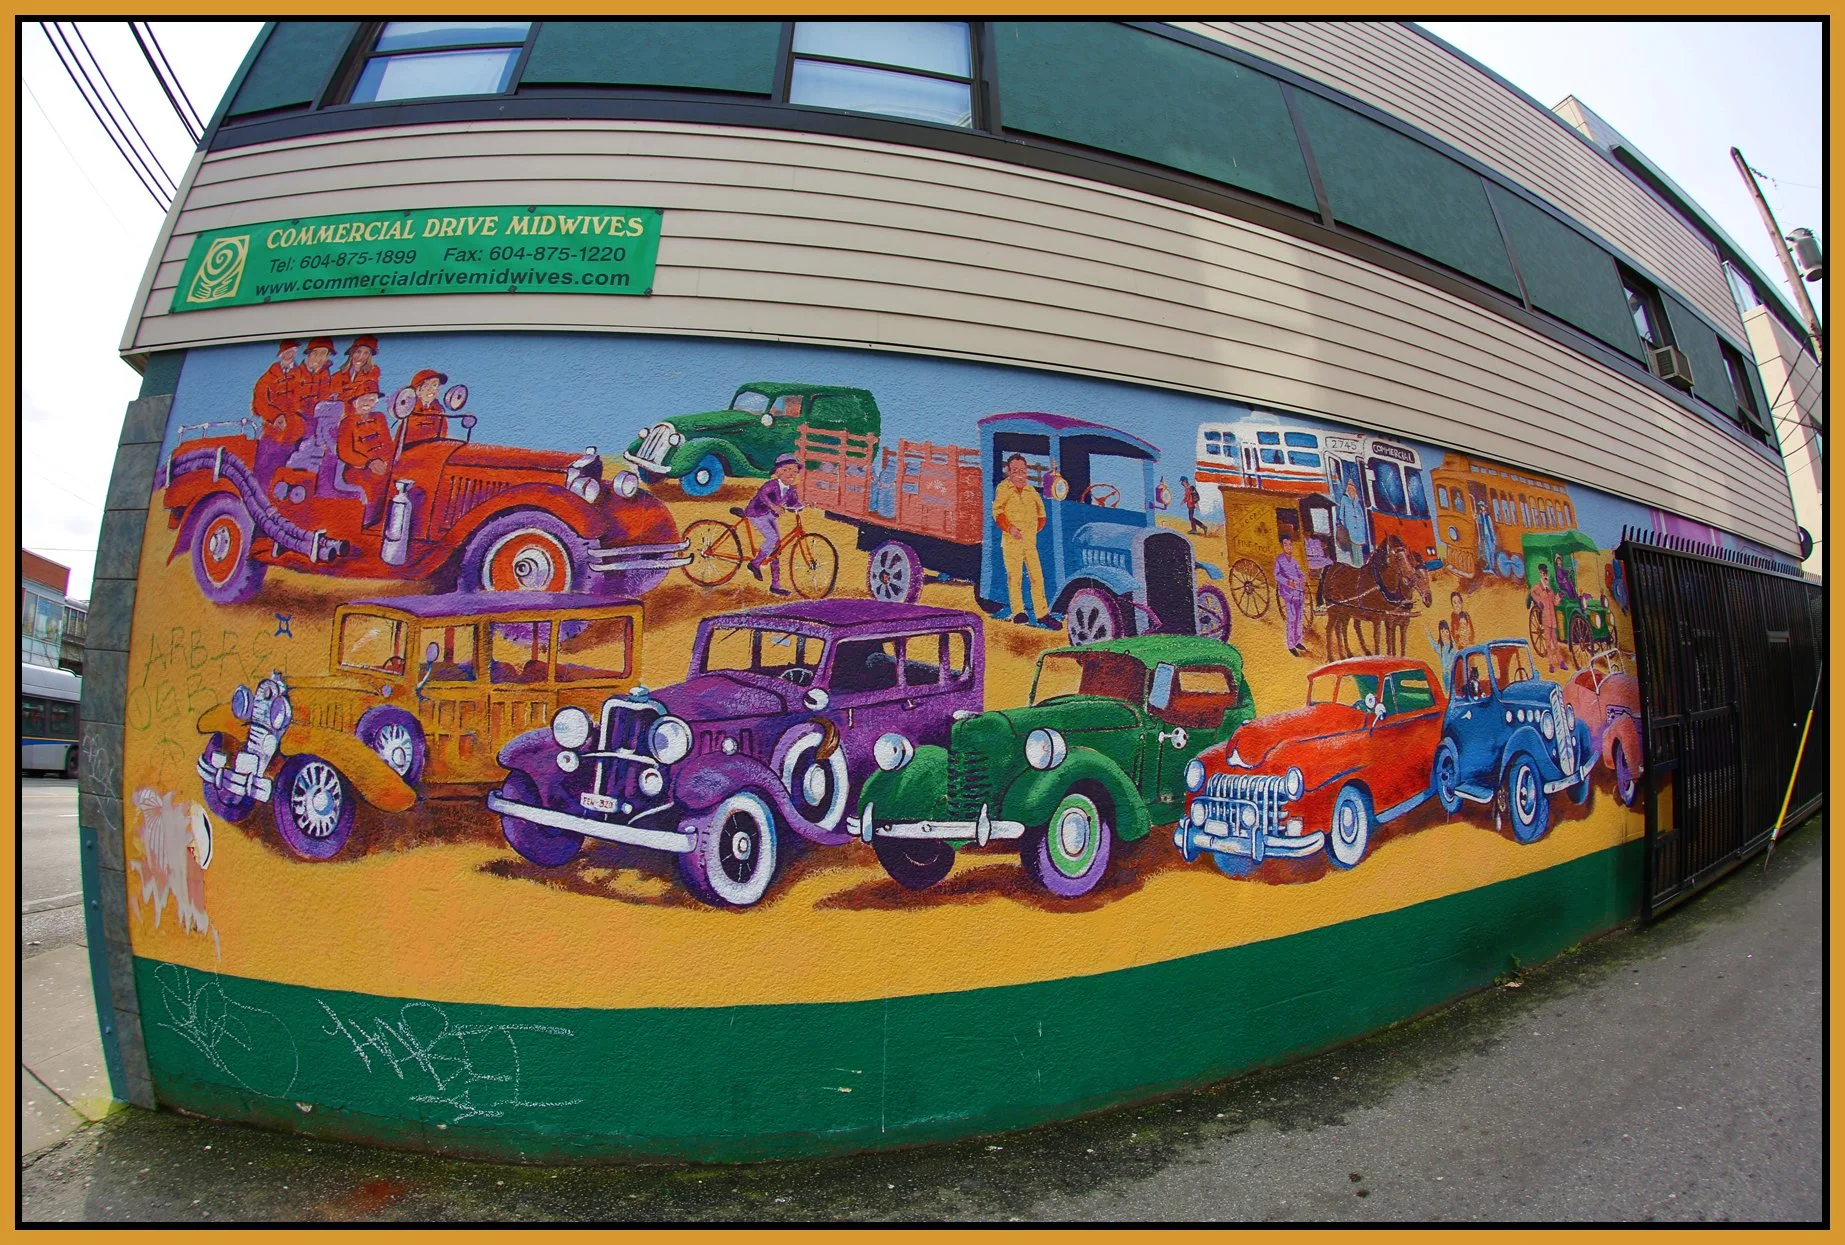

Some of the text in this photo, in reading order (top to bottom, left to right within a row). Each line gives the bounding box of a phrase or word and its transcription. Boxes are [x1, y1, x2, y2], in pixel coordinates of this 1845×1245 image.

[266, 215, 644, 249] COMMERCIAL DRIVE MIDWIVES
[269, 246, 626, 273] Tel: 604-875-1899 Fax: 604-875-1220
[255, 267, 630, 297] www.commercialdrivemidwives.com
[1331, 439, 1358, 451] 2745
[1372, 443, 1413, 463] COMMERCIAL
